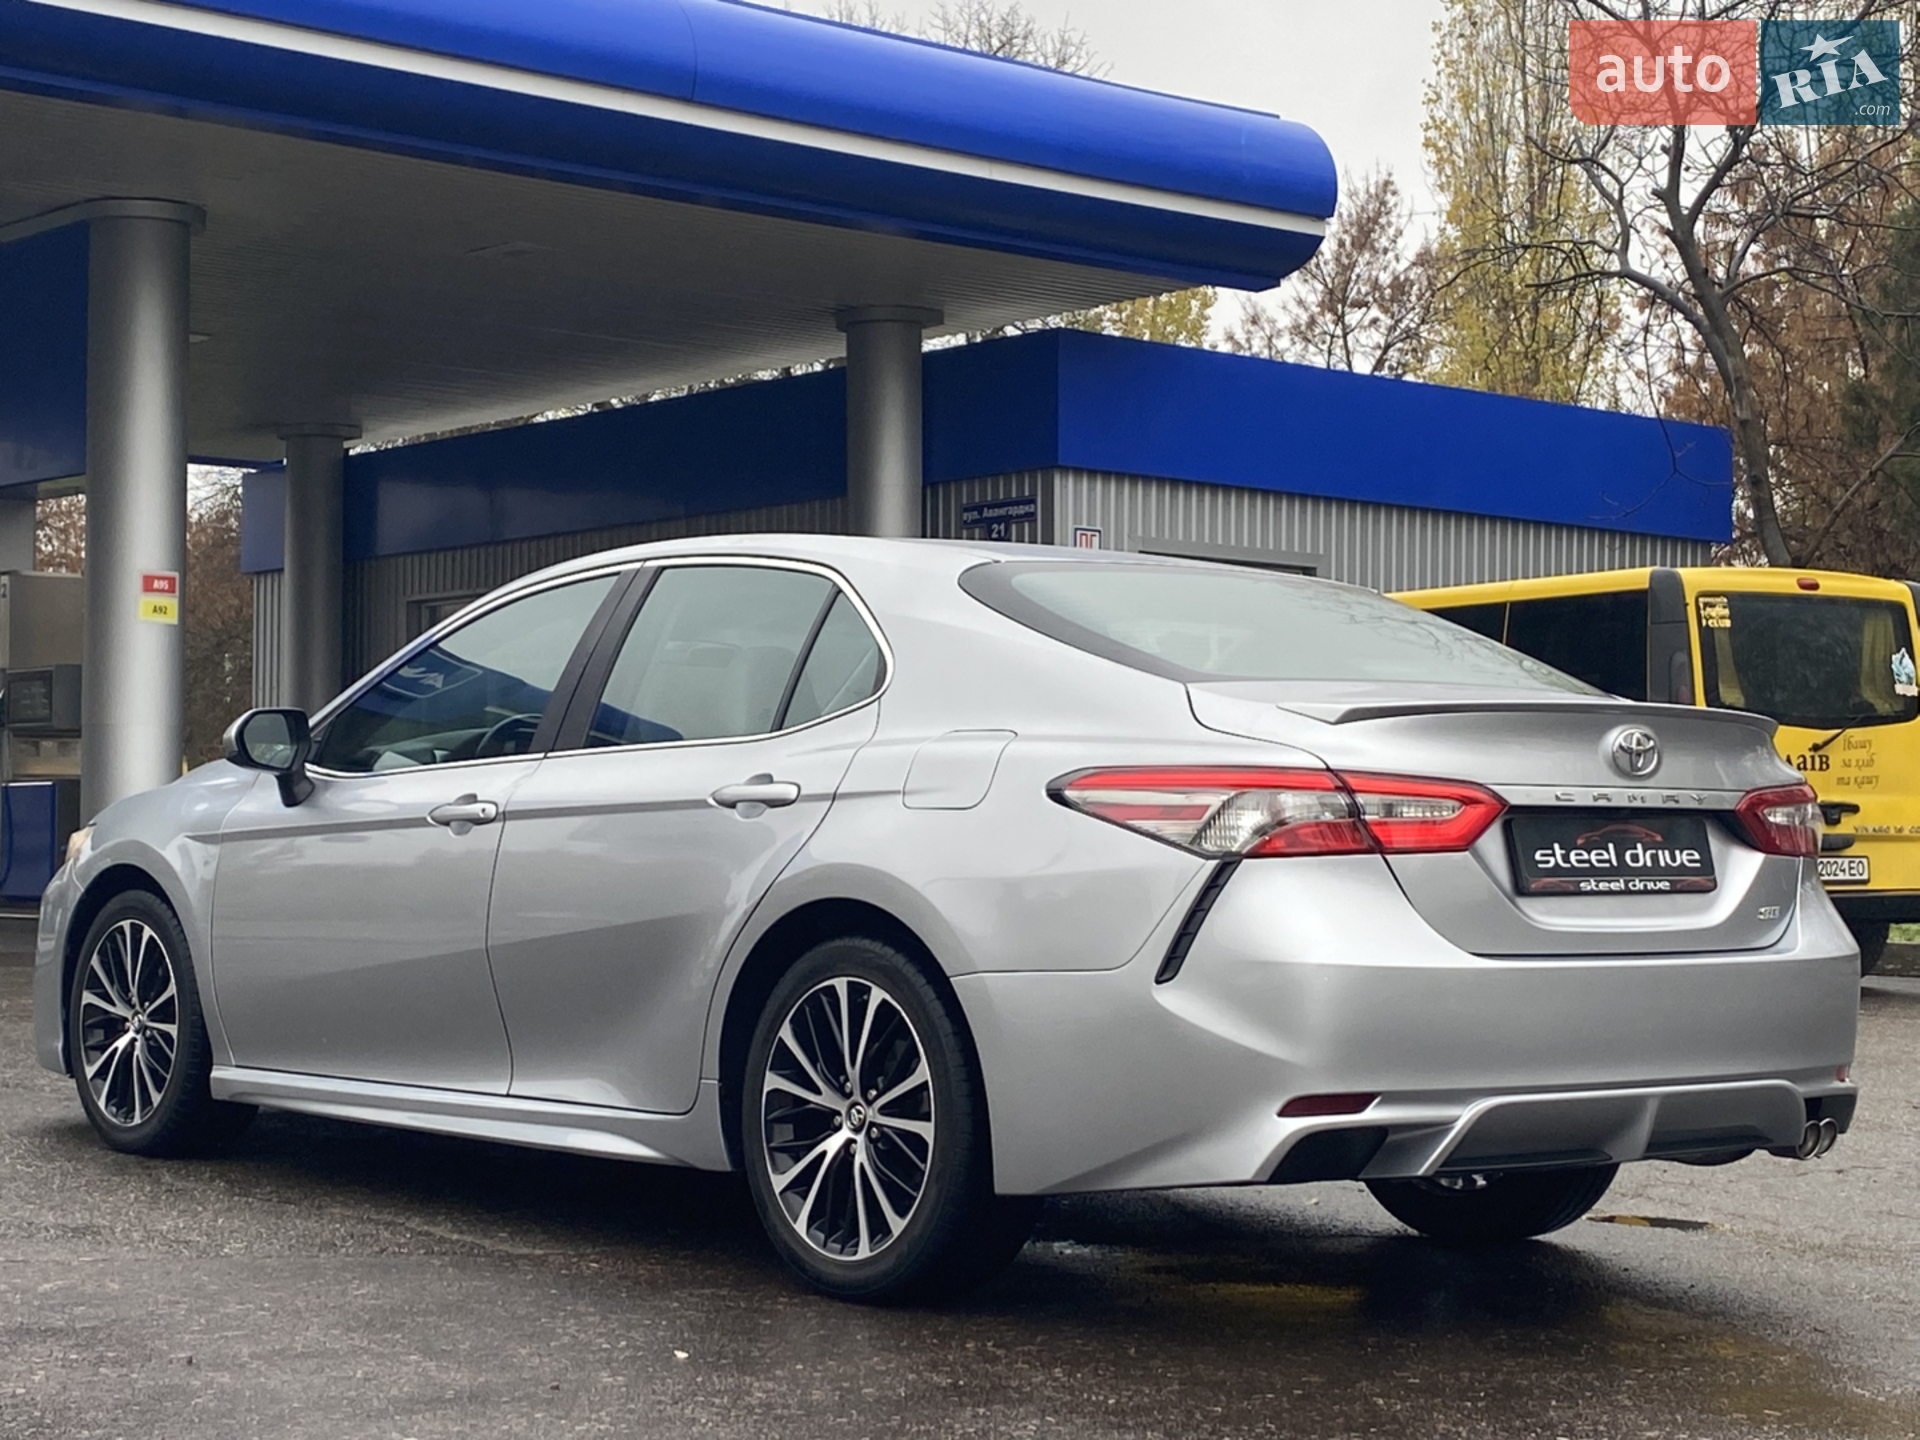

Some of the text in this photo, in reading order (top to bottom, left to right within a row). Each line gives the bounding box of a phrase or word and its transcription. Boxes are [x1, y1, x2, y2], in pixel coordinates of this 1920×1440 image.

[991, 522, 1005, 538] 21
[1554, 791, 1707, 805] CAMRY
[1534, 842, 1701, 868] steel drive
[1579, 878, 1671, 891] steel drive
